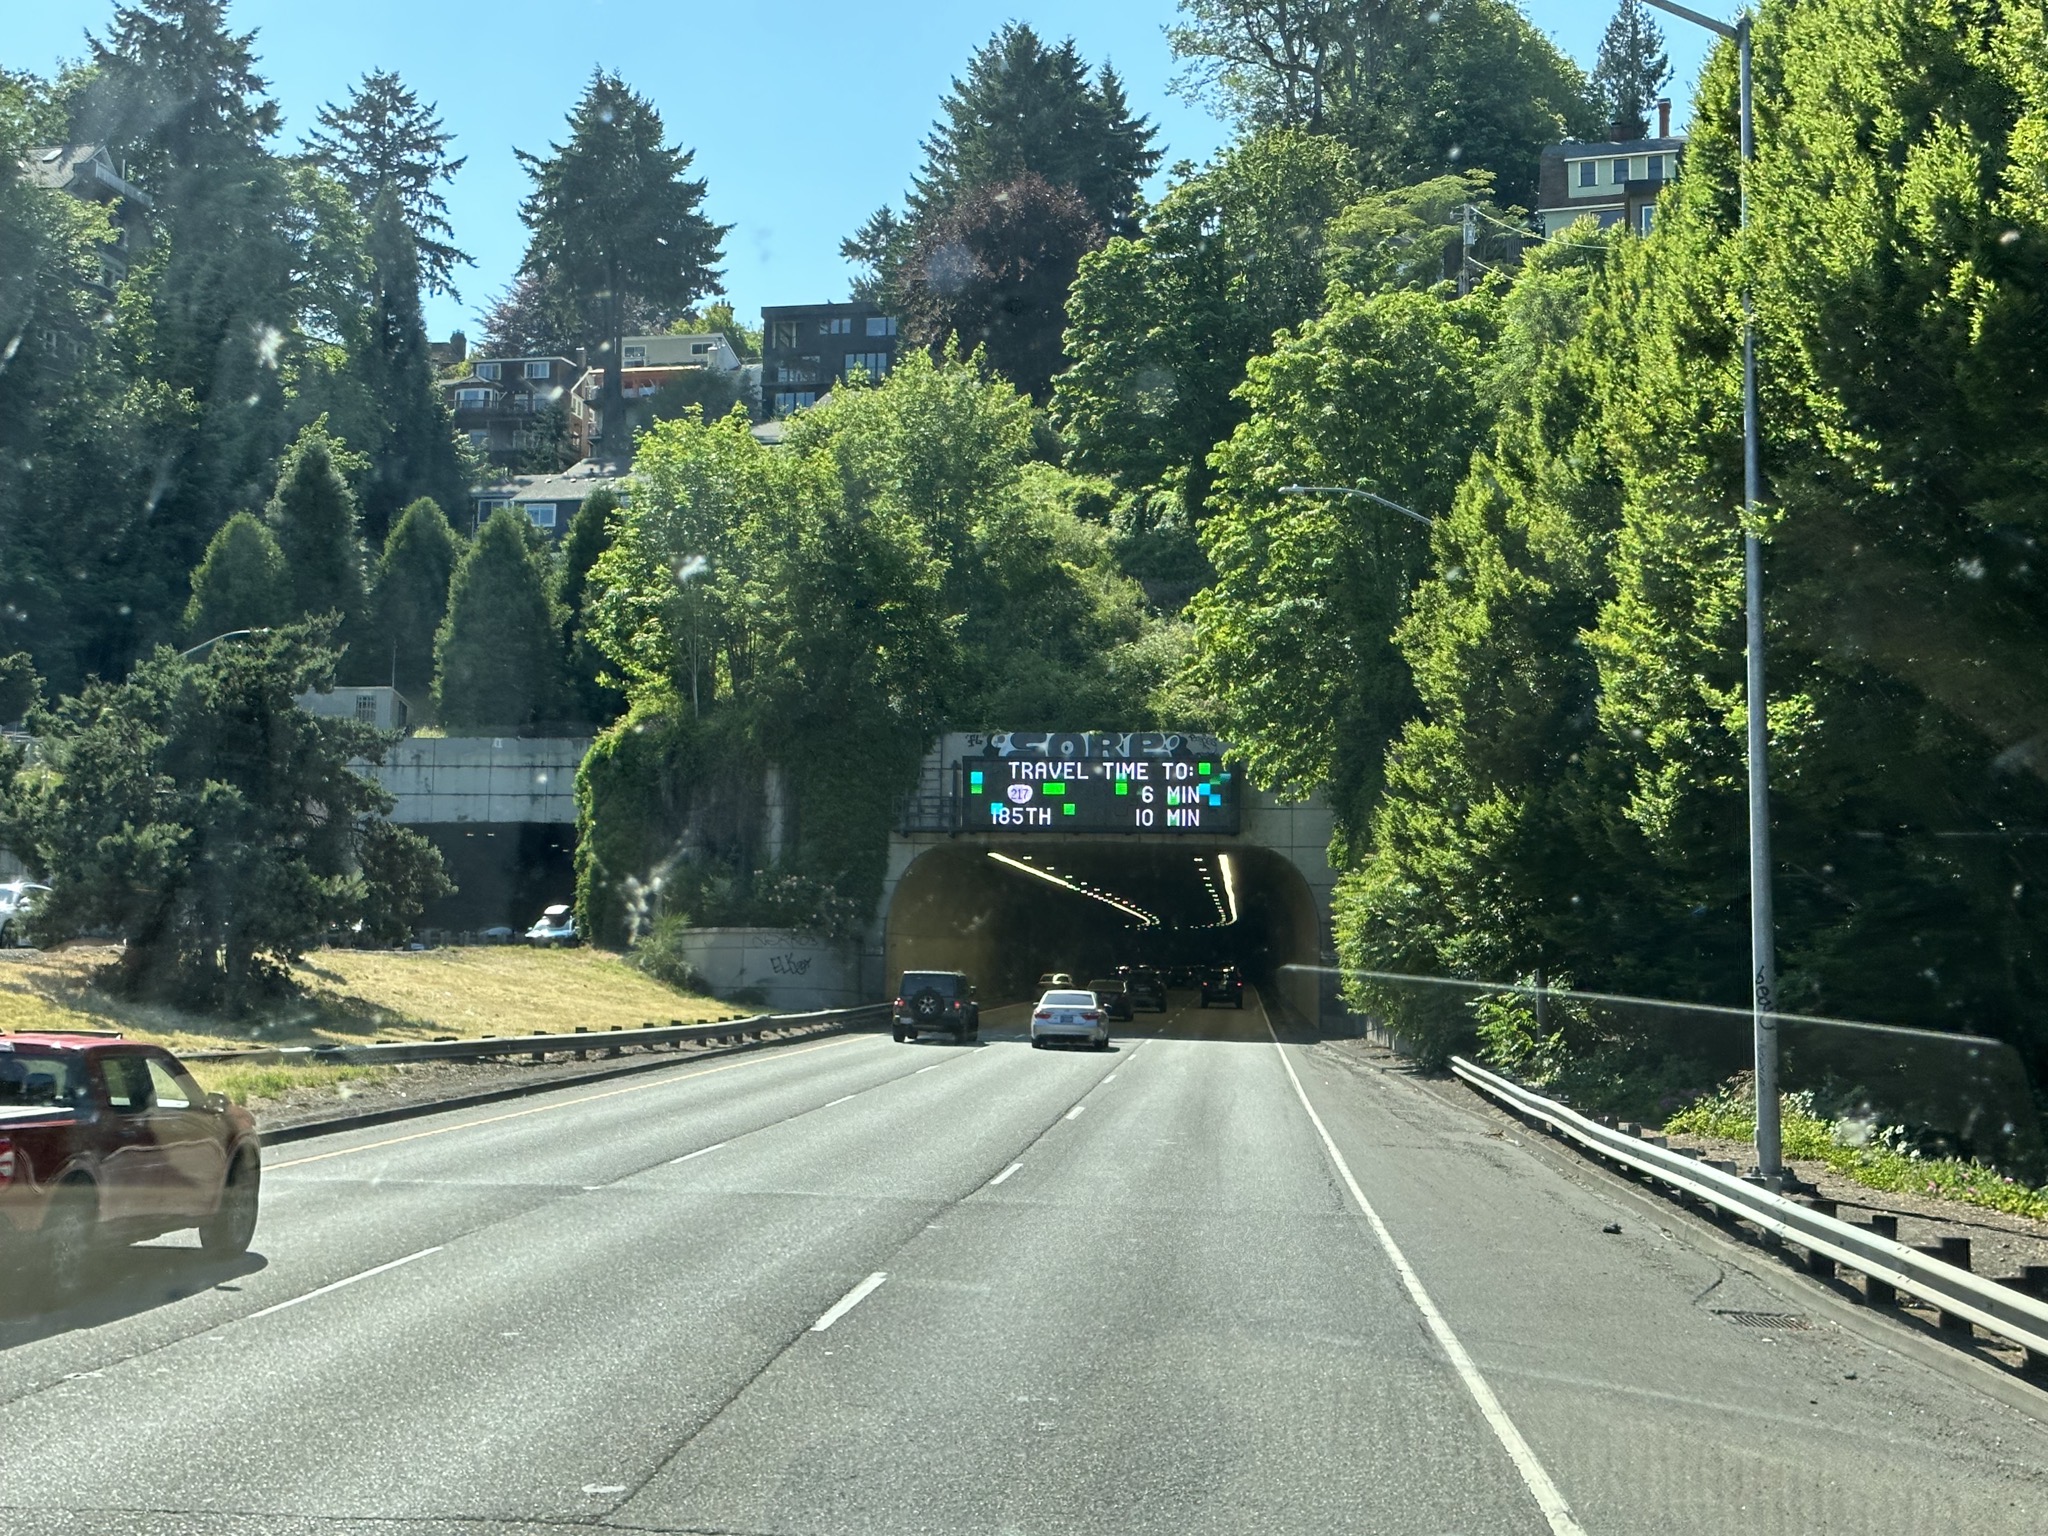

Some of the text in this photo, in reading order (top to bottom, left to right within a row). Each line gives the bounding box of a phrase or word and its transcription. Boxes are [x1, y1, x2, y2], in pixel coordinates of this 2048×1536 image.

[1008, 761, 1194, 780] TRAVEL TIME TO:
[1010, 788, 1029, 800] 217
[1141, 785, 1200, 804] 6 MIN
[992, 807, 1052, 825] 185TH
[1135, 808, 1200, 827] 10 MIN
